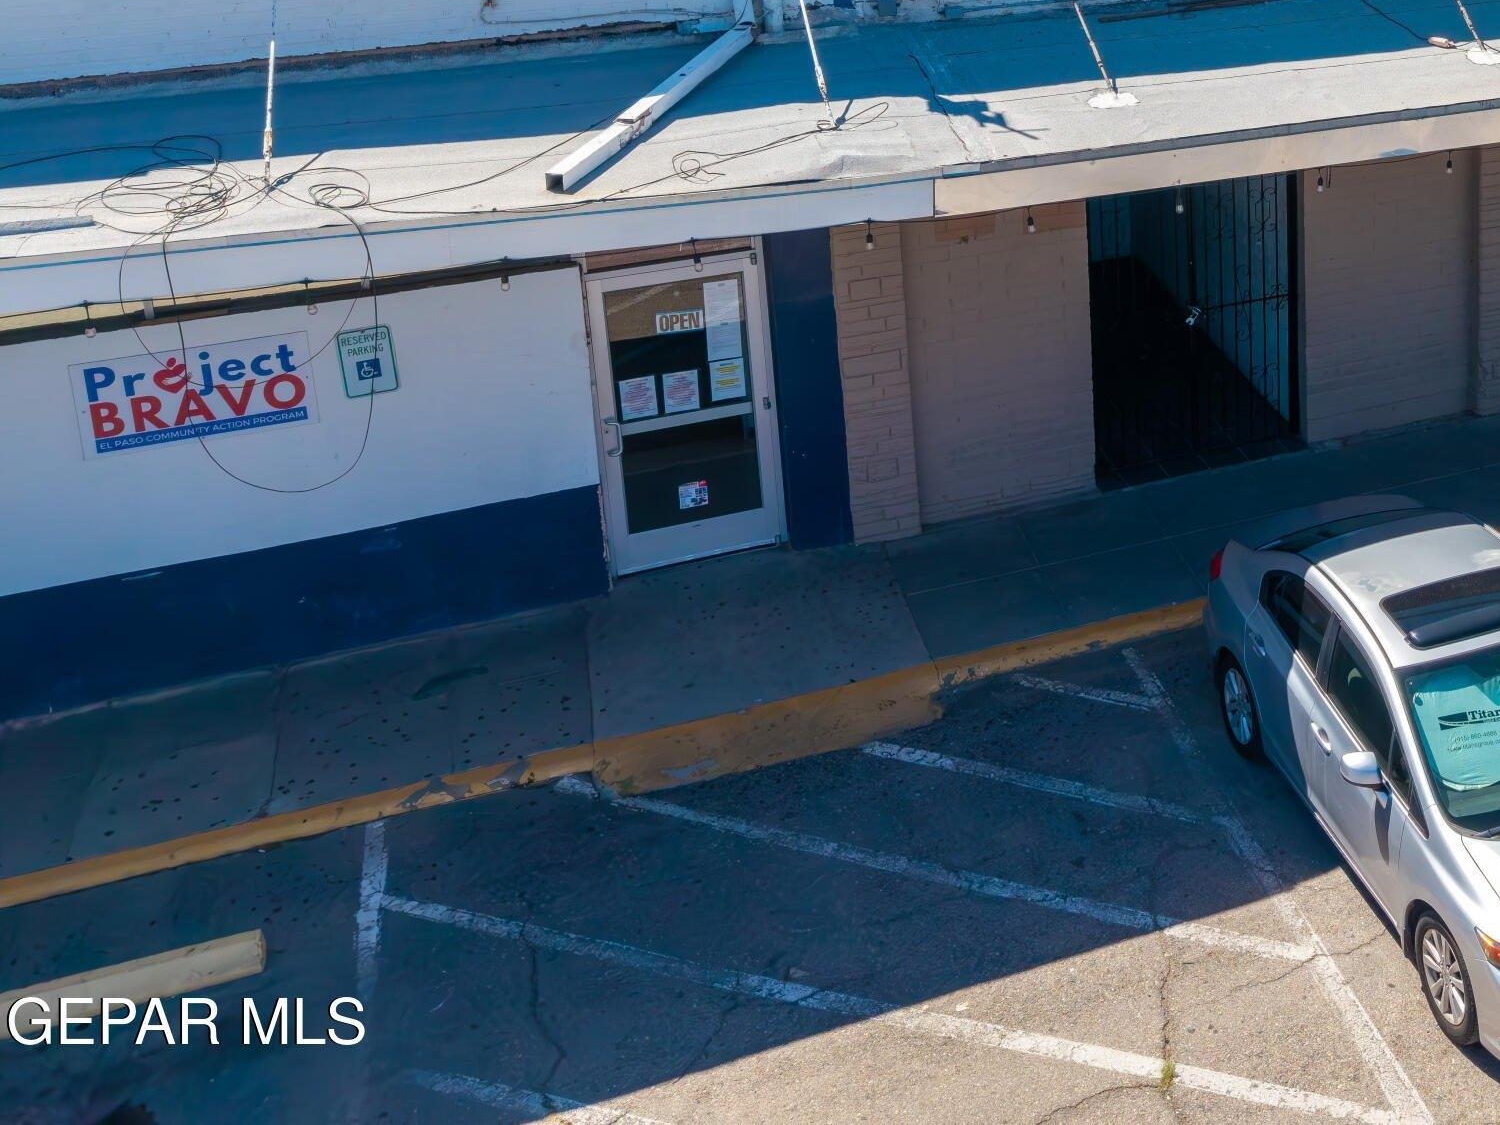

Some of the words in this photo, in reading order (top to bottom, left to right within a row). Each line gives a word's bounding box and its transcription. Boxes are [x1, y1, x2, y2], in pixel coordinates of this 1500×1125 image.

[660, 311, 700, 332] OPEN
[341, 331, 387, 347] RESERVED
[348, 343, 384, 356] PARKING
[89, 374, 306, 439] BRAVO
[100, 441, 112, 450] EL
[114, 436, 144, 448] PASO
[213, 419, 251, 432] ACTION
[253, 410, 305, 425] PROGRAM
